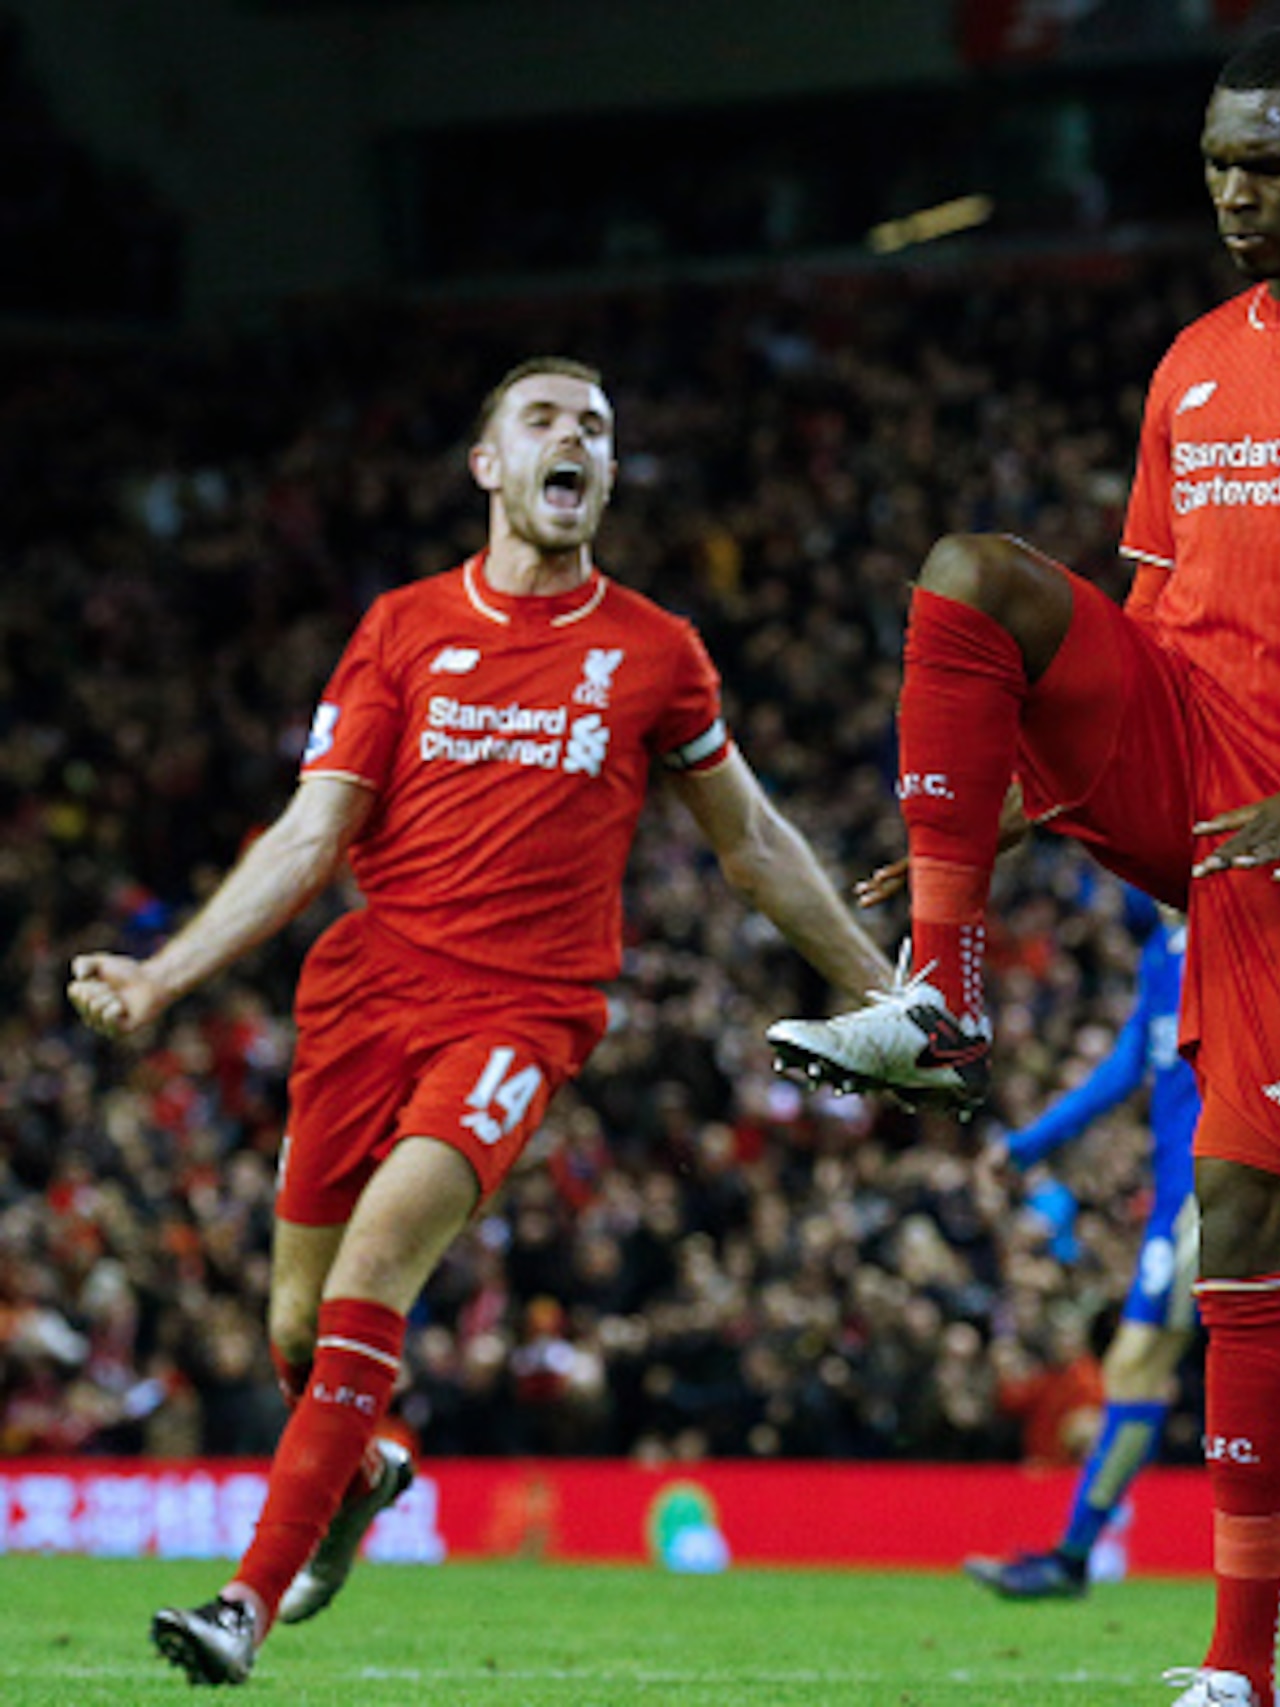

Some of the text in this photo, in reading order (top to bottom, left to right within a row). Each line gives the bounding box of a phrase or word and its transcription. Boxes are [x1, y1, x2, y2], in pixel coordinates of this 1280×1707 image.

[427, 695, 567, 736] Standard
[420, 729, 563, 769] Chartered
[463, 1044, 544, 1137] 14
